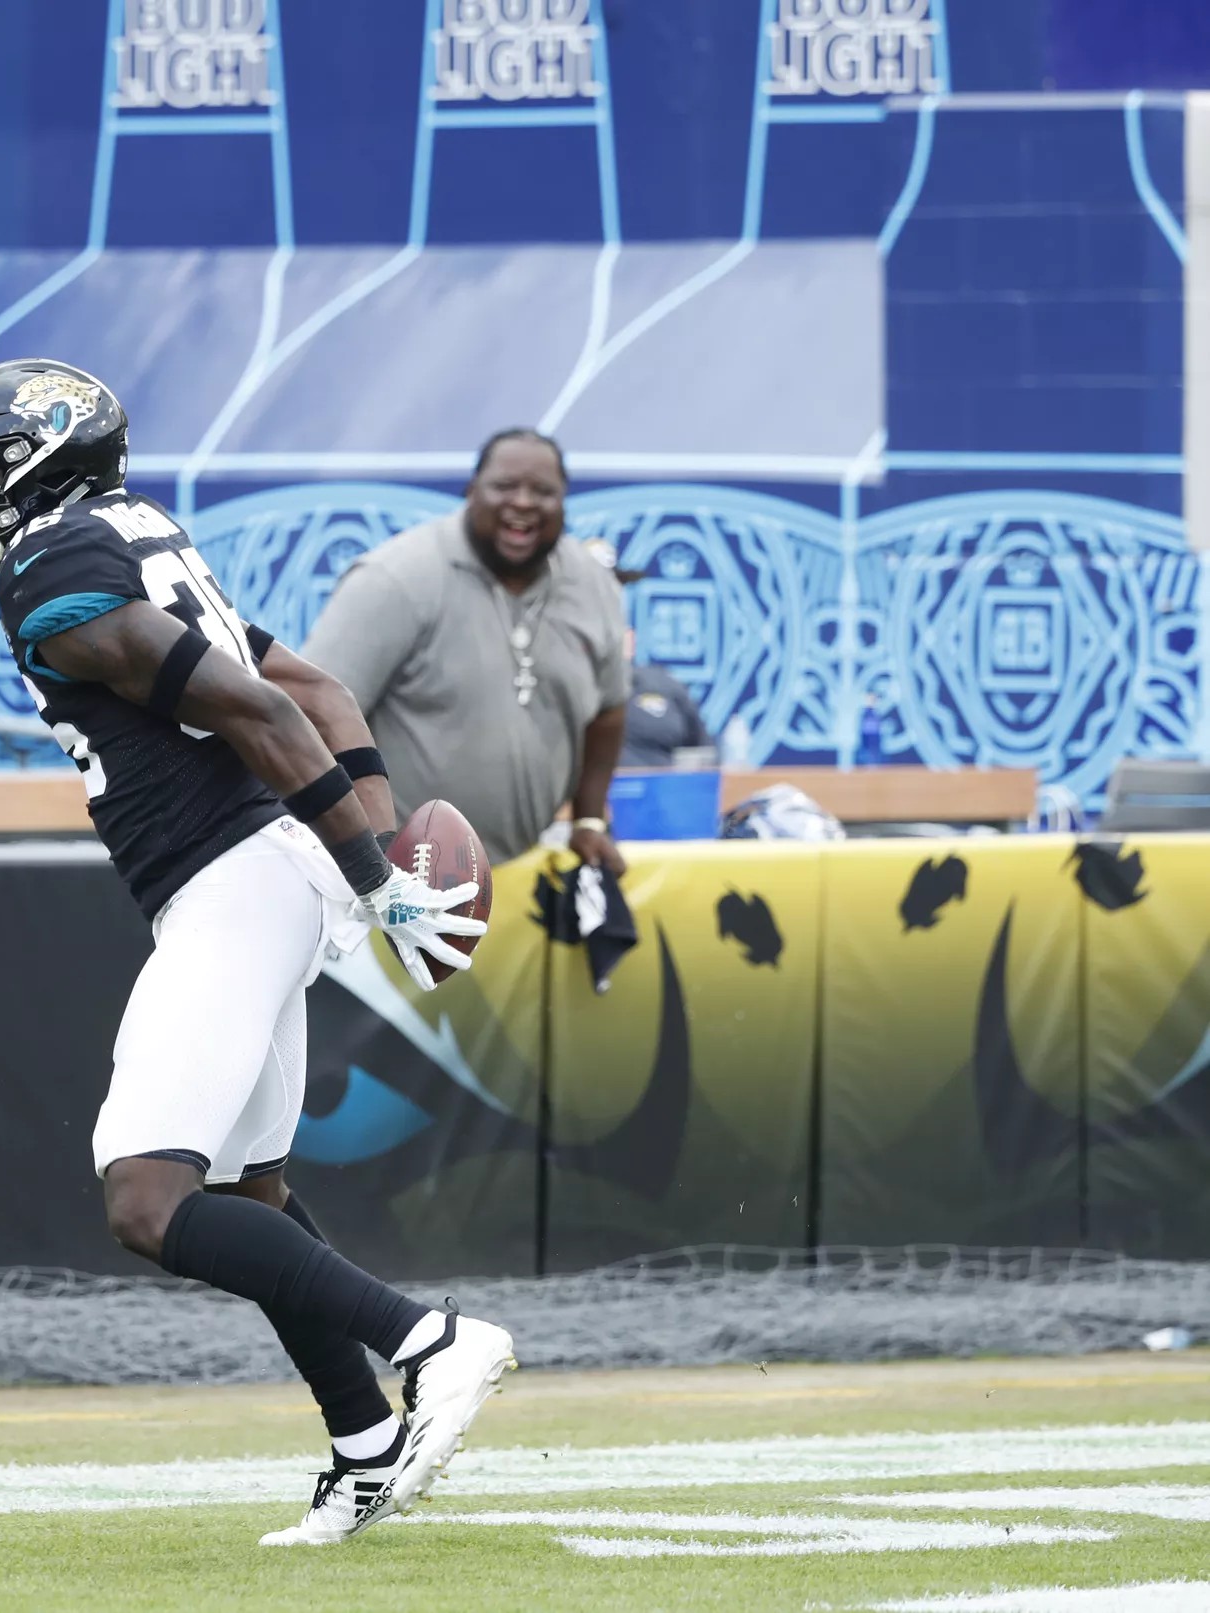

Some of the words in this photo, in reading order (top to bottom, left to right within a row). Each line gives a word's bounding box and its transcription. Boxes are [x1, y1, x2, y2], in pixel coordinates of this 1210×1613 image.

[111, 38, 277, 108] LIGHT
[431, 29, 603, 101] LIGHT
[765, 20, 941, 95] LIGHT
